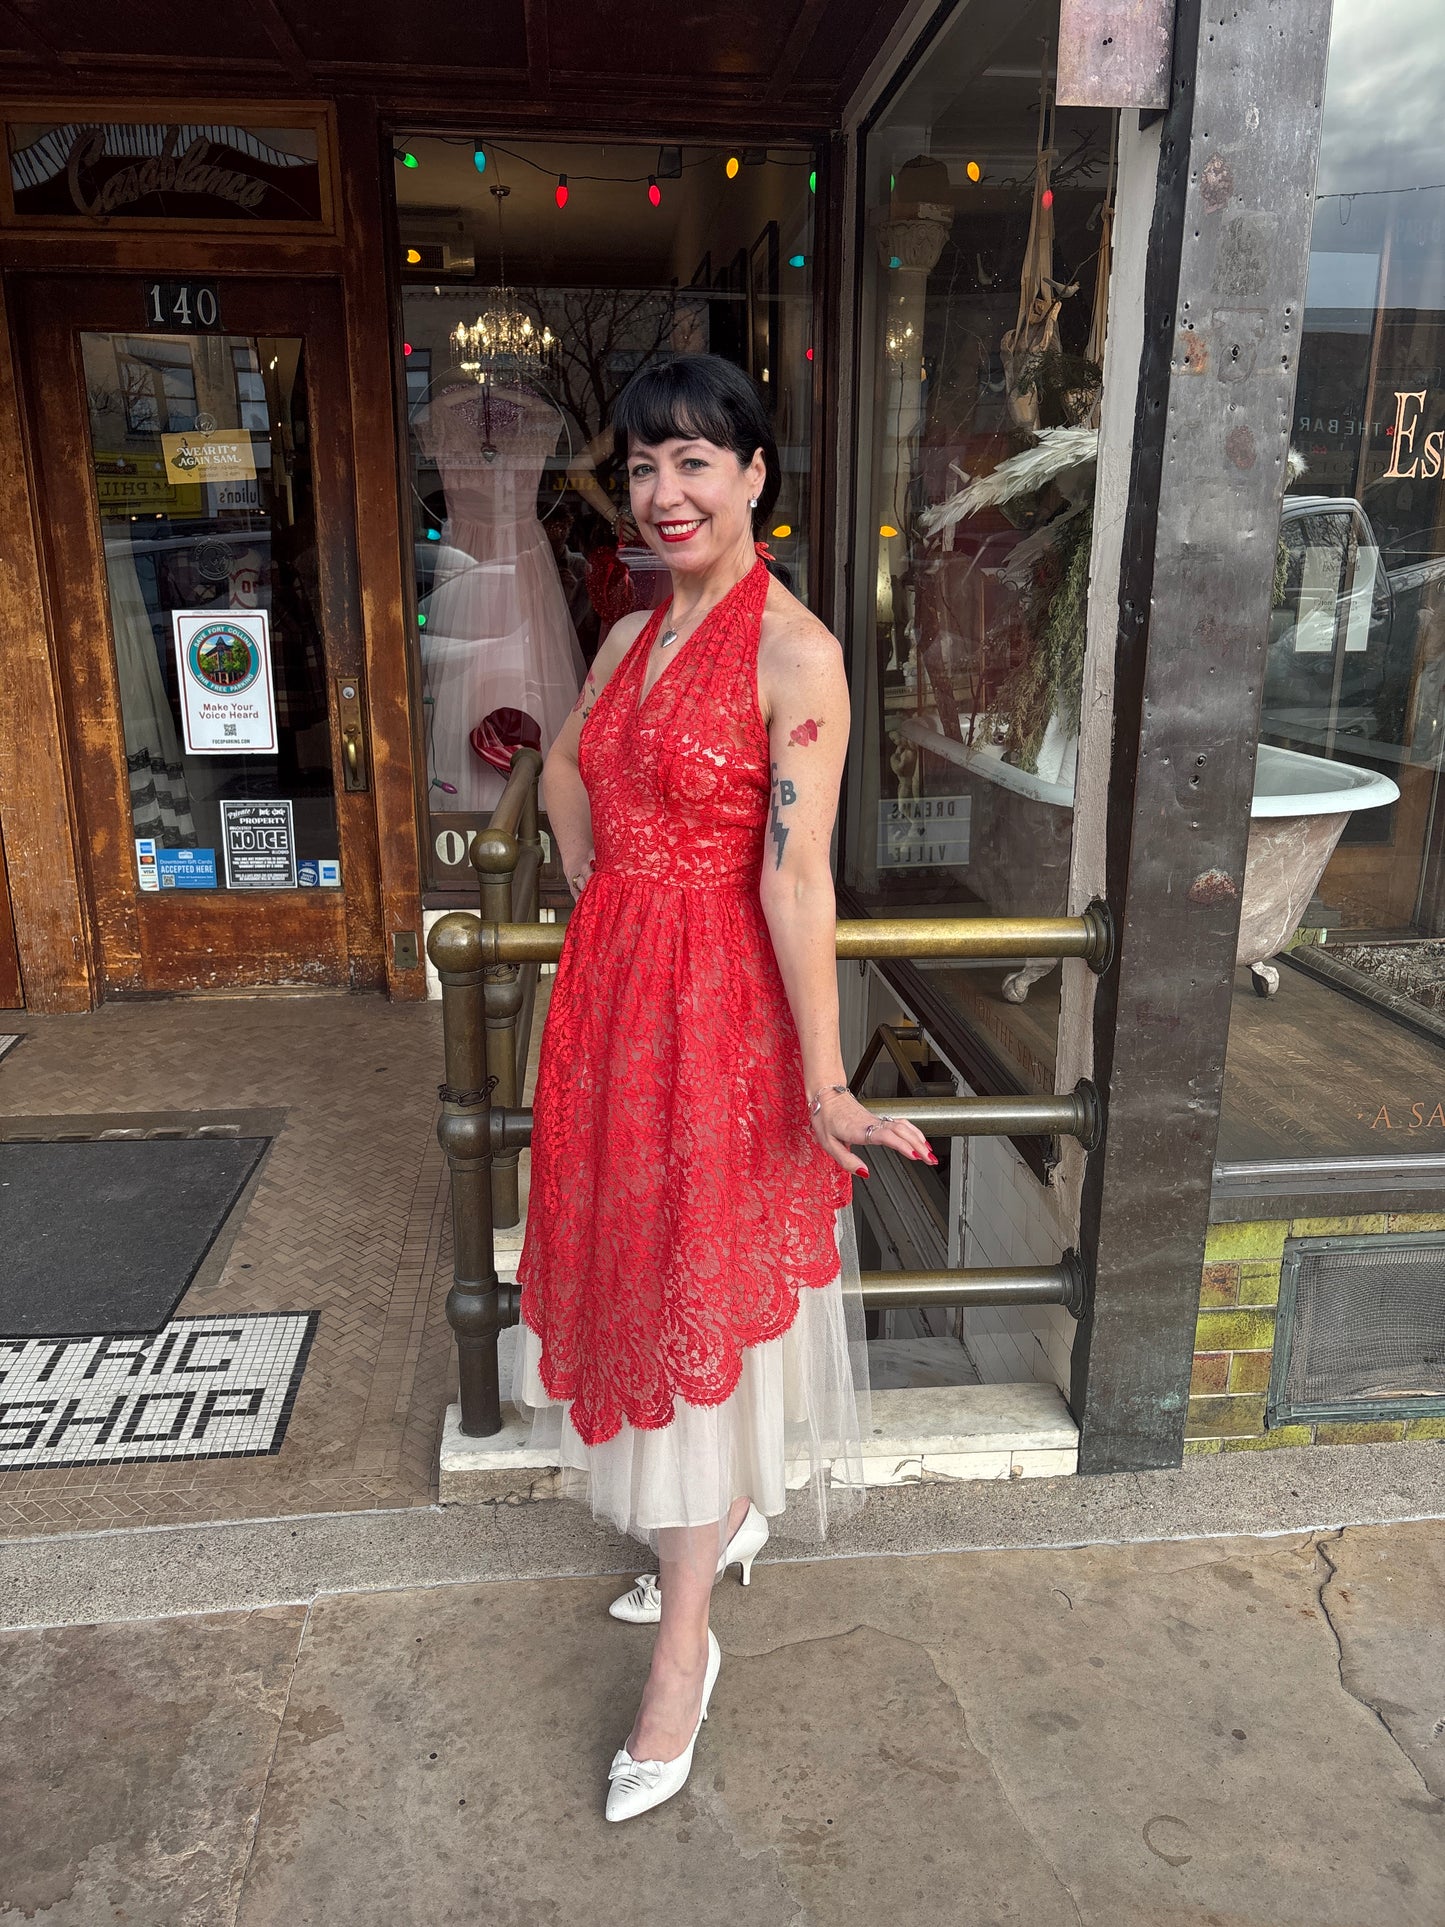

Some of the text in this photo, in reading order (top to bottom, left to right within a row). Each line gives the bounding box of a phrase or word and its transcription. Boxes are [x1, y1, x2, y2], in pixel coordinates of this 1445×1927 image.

[150, 284, 217, 325] 140
[1383, 389, 1445, 479] Es
[176, 445, 230, 457] WEAR IT
[178, 456, 210, 467] AGAIN
[208, 626, 225, 635] FORT
[227, 627, 253, 648] COLLINS
[209, 683, 228, 693] FREE
[230, 674, 254, 693] PARKING
[198, 710, 259, 720] Voice Heard
[203, 702, 254, 712] Make Your
[239, 817, 287, 825] PROPERTY
[230, 830, 288, 850] NO ICE
[160, 864, 214, 874] ACCEPTED HERE
[1369, 1104, 1393, 1129] A
[0, 1329, 243, 1383] TRIC
[0, 1387, 266, 1450] SHOP
